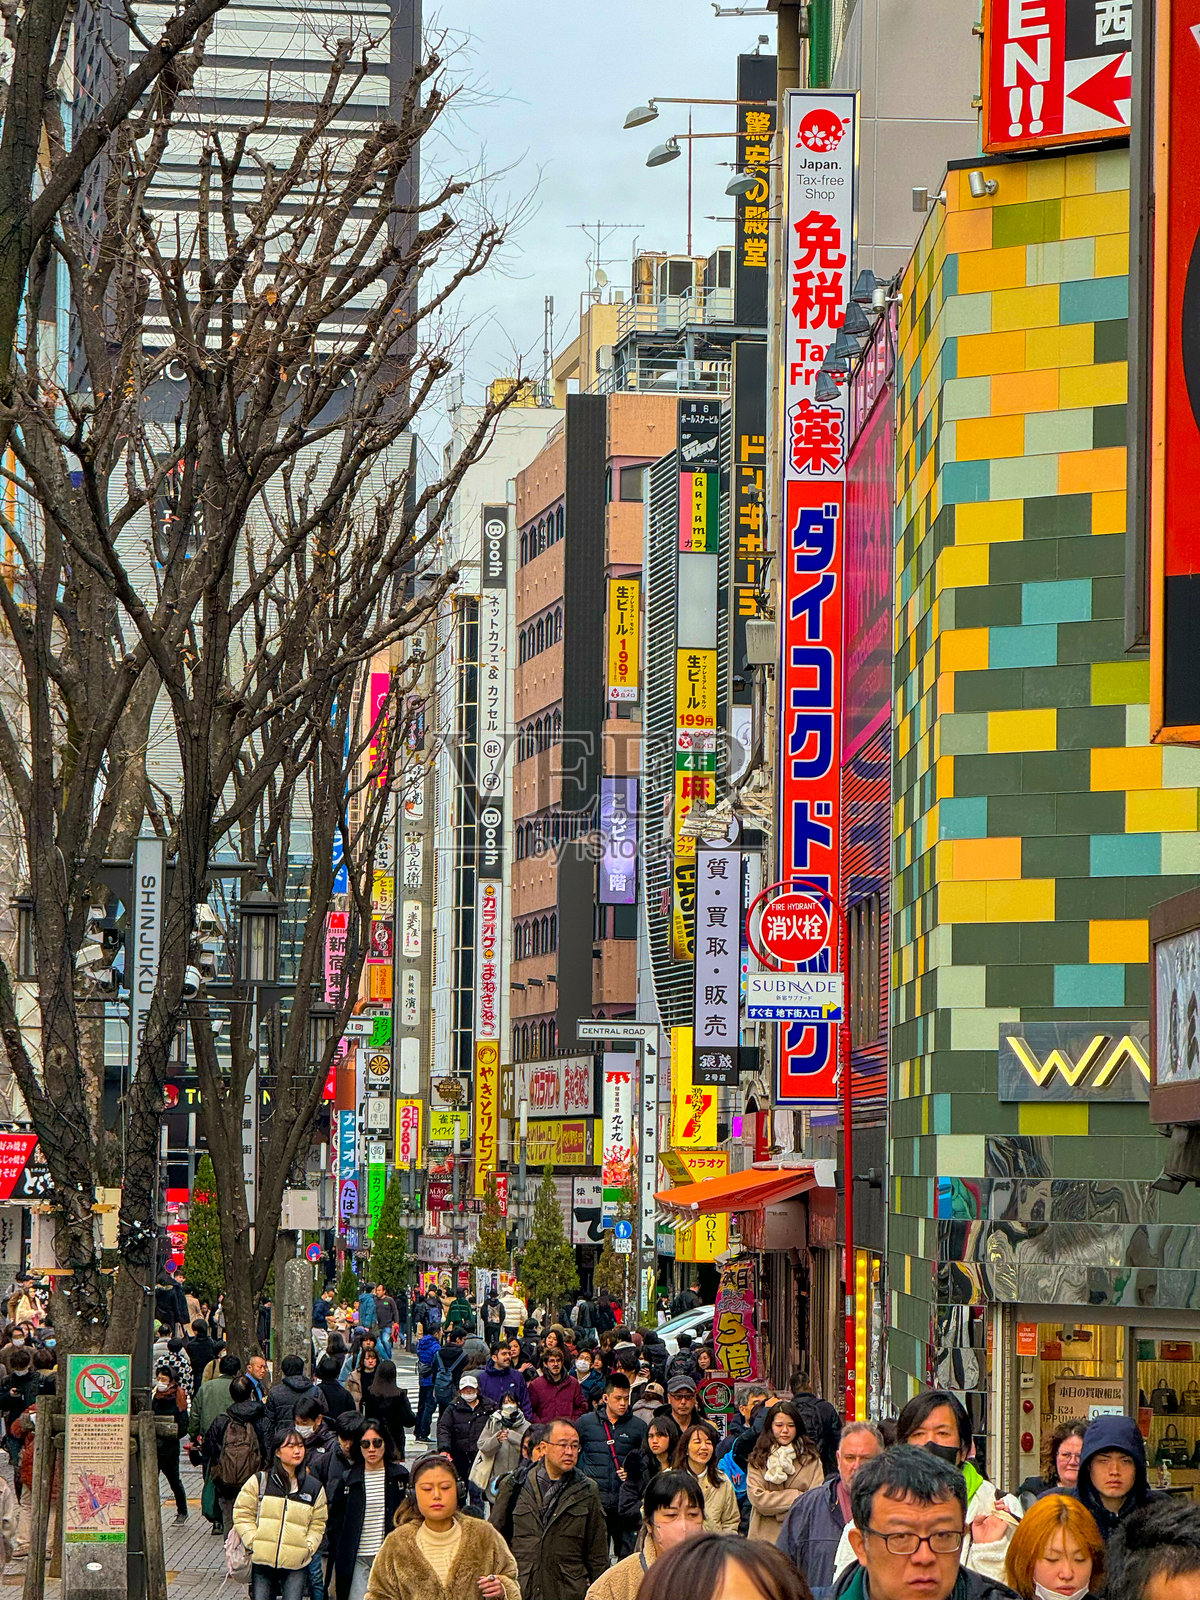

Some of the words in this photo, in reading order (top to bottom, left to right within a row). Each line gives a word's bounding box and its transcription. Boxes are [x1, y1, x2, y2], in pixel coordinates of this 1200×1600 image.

[799, 158, 842, 171] Japan.
[797, 174, 845, 186] Tax-free
[805, 188, 835, 201] Shop
[791, 210, 847, 330] 免税
[795, 339, 831, 362] Ta
[792, 406, 842, 471] 薬
[692, 477, 705, 535] Garam
[485, 518, 506, 577] Booth
[684, 540, 712, 549] ガラム
[616, 586, 629, 636] 生ビール
[687, 655, 701, 709] 生ビール
[679, 714, 713, 726] 199円
[683, 755, 708, 770] 4F
[481, 807, 502, 866] Booth
[771, 903, 785, 911] FIRE
[787, 902, 816, 911] HYDRANT
[138, 875, 156, 995] SHINJUKU
[482, 896, 496, 949] カラオケ
[767, 914, 823, 941] 消火栓
[752, 979, 837, 995] SUBNADE
[480, 963, 496, 1037] まねきねこ
[749, 1008, 773, 1018] すぐ右
[776, 1008, 820, 1018] 地下街入口
[582, 1027, 620, 1035] CENTRAL
[611, 1115, 624, 1142] 九十九
[688, 1158, 725, 1168] カラオケ
